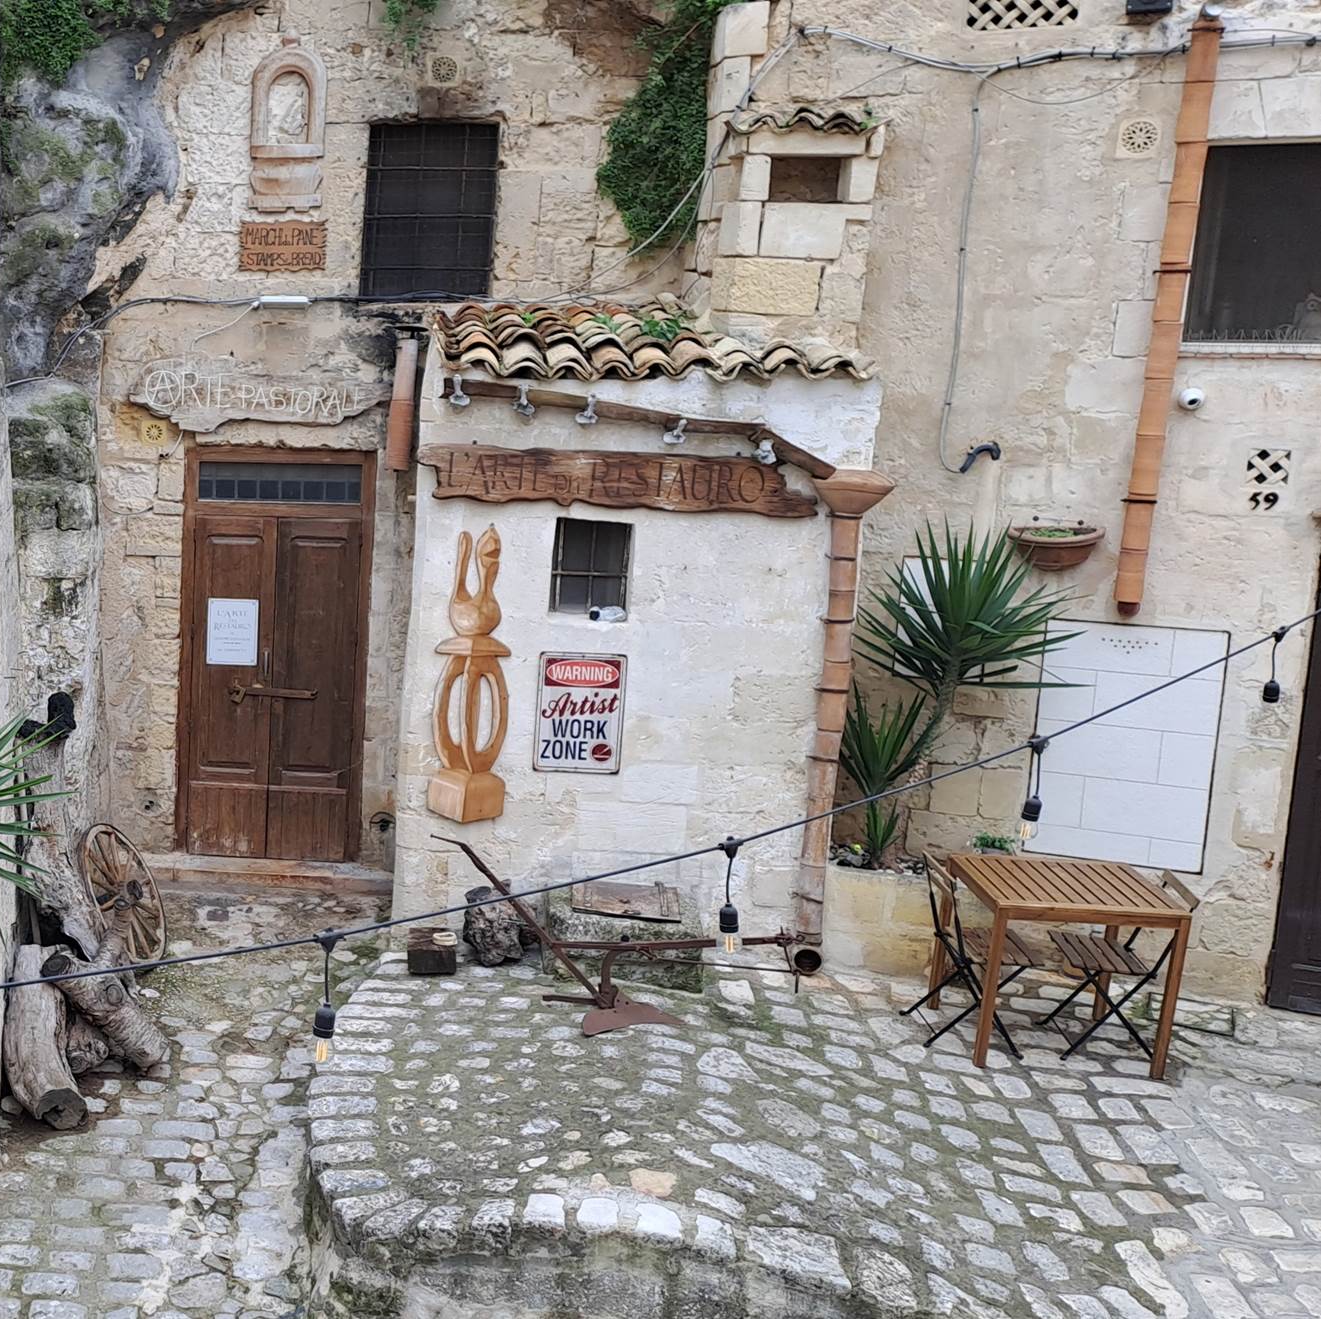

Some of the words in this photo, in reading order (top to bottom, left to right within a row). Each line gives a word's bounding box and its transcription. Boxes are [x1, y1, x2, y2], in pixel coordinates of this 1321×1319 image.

[292, 227, 319, 247] PANE
[145, 370, 232, 408] ARTE
[240, 384, 366, 417] PASTORALE
[1248, 491, 1280, 512] 59
[551, 665, 613, 682] WARNING
[541, 691, 620, 719] Artist
[551, 718, 609, 740] WORK
[540, 739, 589, 761] ZONE
